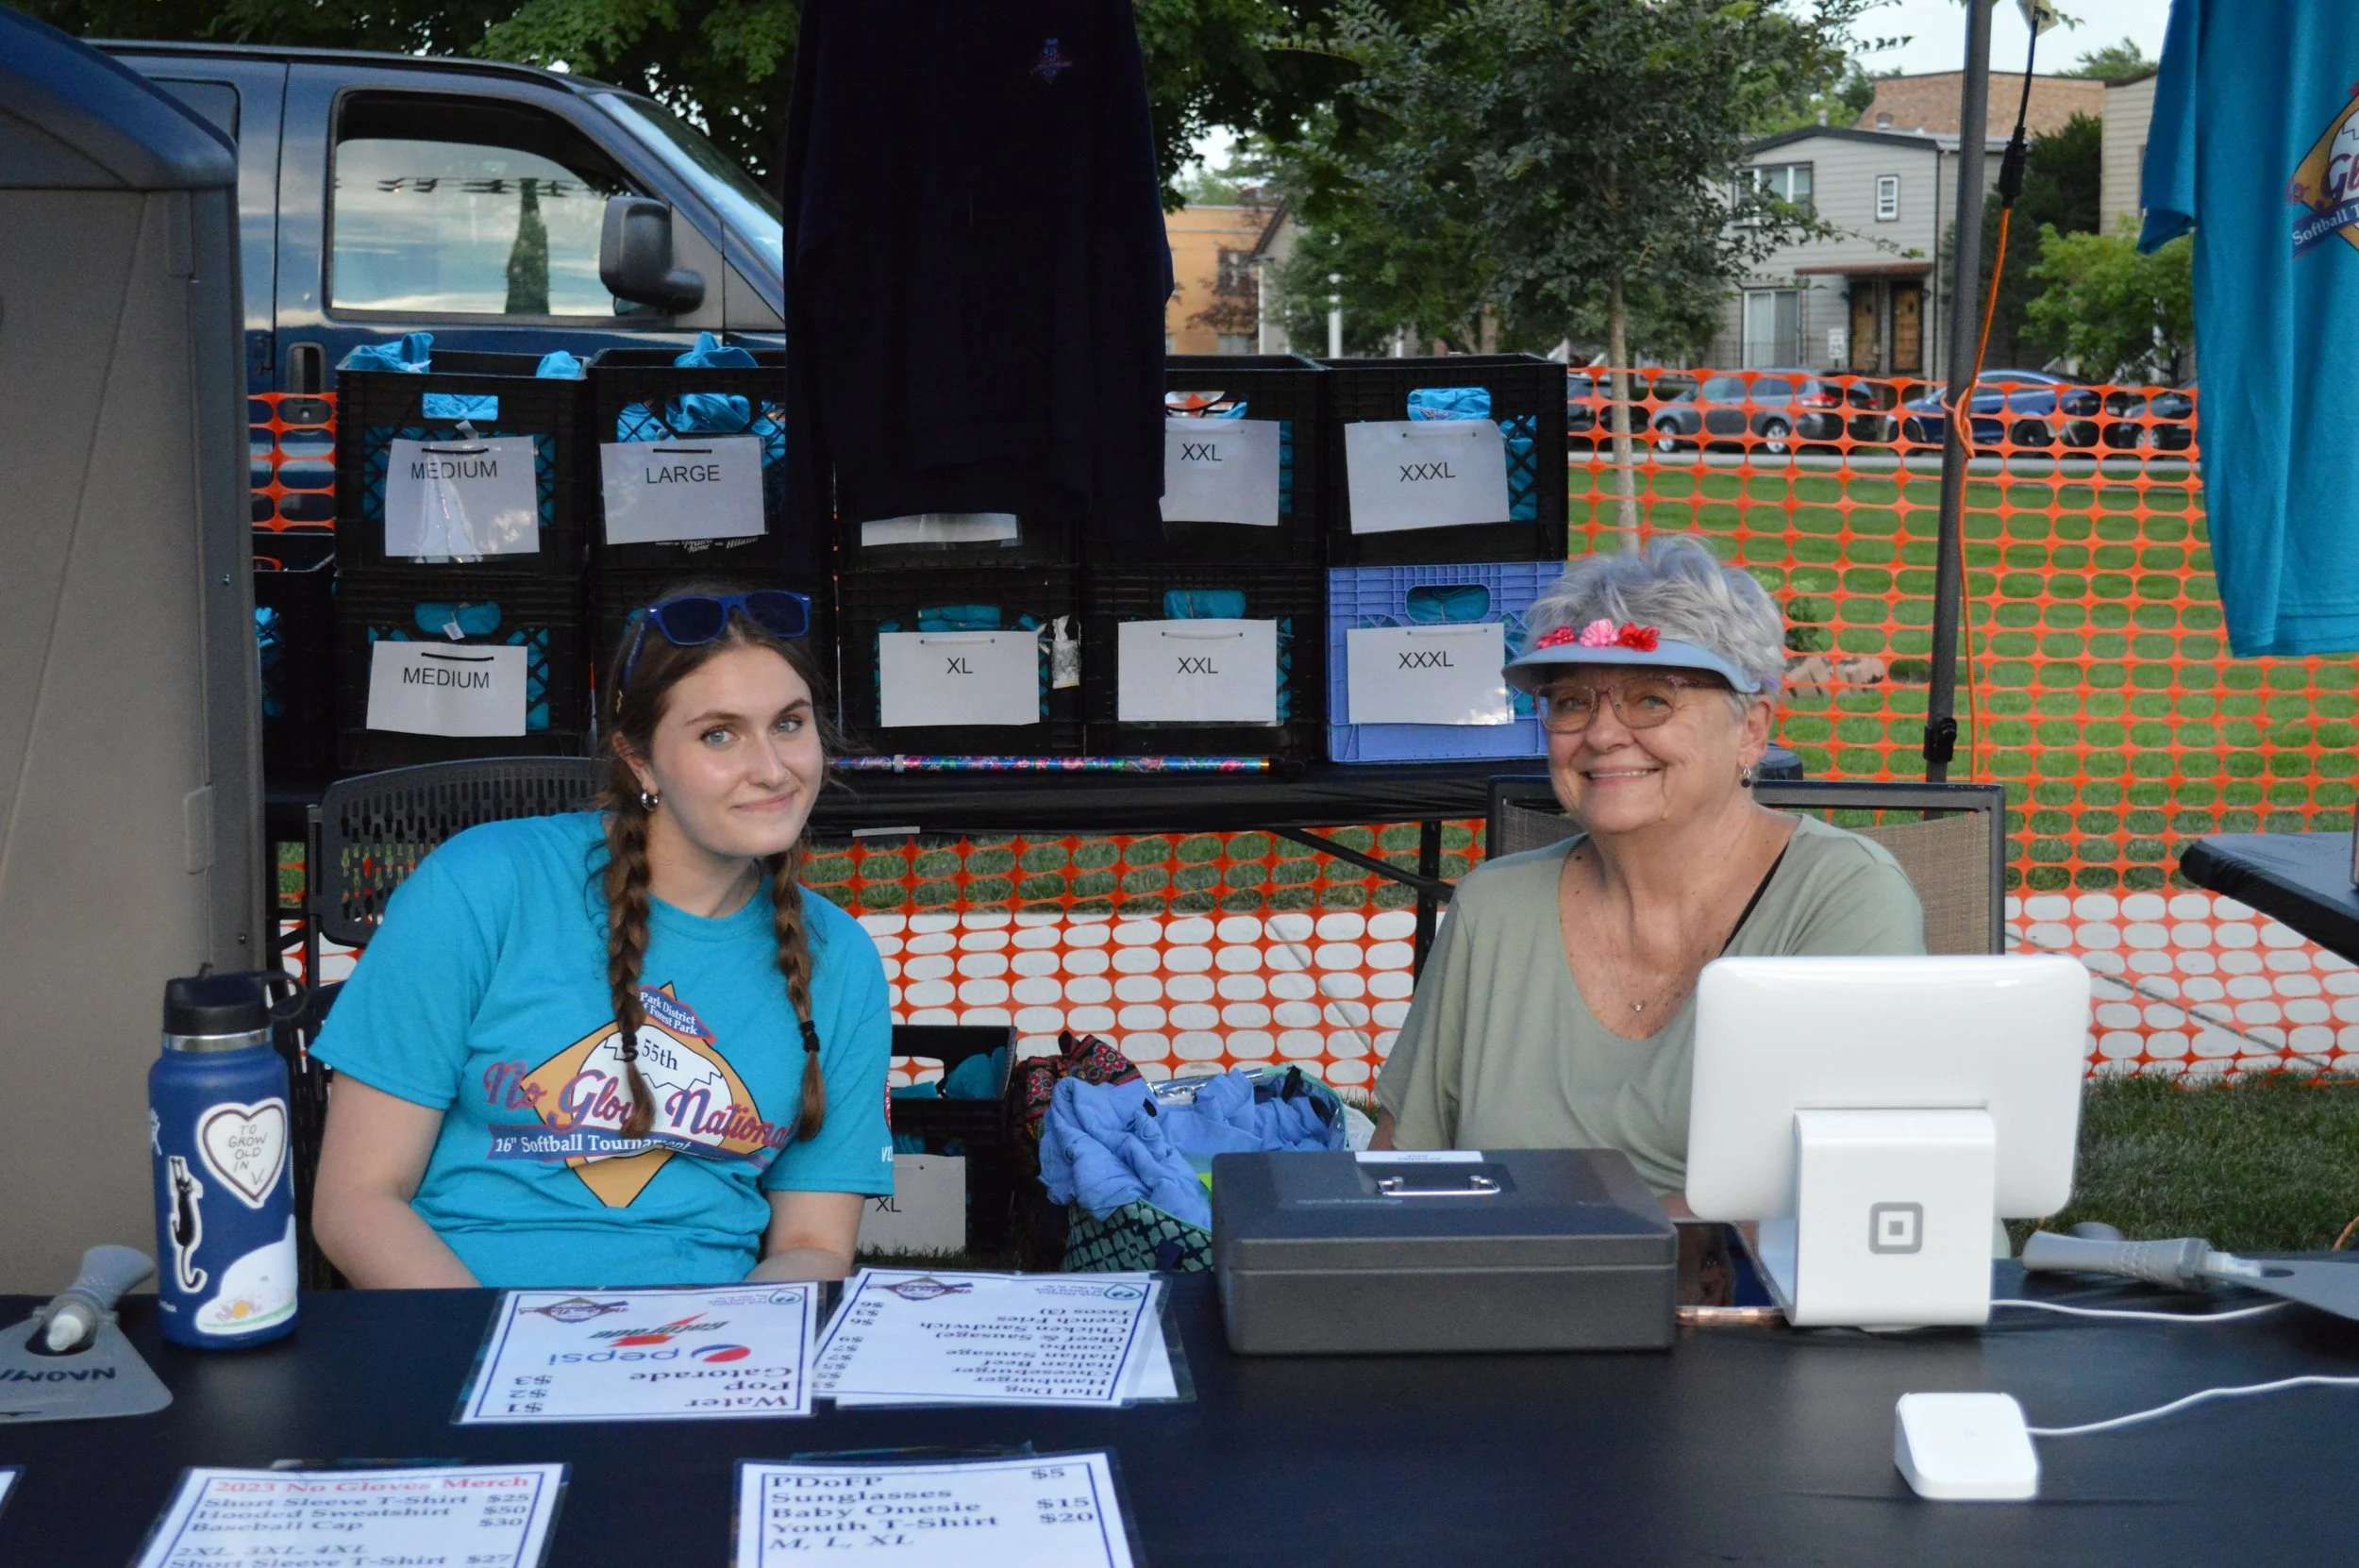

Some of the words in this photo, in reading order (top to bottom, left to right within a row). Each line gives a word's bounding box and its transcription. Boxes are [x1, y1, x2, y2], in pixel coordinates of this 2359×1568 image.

[2292, 208, 2350, 245] Softball
[1181, 443, 1223, 461] XXL
[410, 459, 498, 480] MEDIUM
[645, 464, 721, 484] LARGE
[1399, 461, 1456, 482] XXXL
[946, 657, 974, 675] XL
[1177, 657, 1219, 675] XXL
[1398, 650, 1455, 669] XXXL
[403, 666, 490, 689] MEDIUM
[640, 992, 661, 1009] Park
[662, 1001, 696, 1025] District
[650, 1004, 673, 1026] Forest
[674, 1020, 698, 1035] Park
[642, 1038, 678, 1071] 55th
[483, 1060, 547, 1111] No
[240, 1124, 258, 1136] TO
[228, 1132, 268, 1148] GROW
[495, 1136, 518, 1153] 16"
[521, 1133, 584, 1153] Softball
[234, 1146, 262, 1160] OLD
[233, 1160, 250, 1172] IN
[876, 1196, 902, 1212] XL
[920, 1322, 1028, 1332] Sandwich
[996, 1315, 1048, 1324] Fries
[935, 1331, 1032, 1341] Sausage)
[1035, 1326, 1127, 1334] Chicken
[548, 1347, 680, 1366] pepsi
[945, 1348, 1037, 1359] Sausage
[0, 1367, 116, 1382] NAOMI
[629, 1366, 793, 1382] Gatorade
[953, 1367, 1113, 1376] Cheeseburger
[514, 1374, 553, 1386] $3
[722, 1380, 792, 1391] Pop
[973, 1376, 1107, 1385] Hamburger
[508, 1388, 548, 1398] $2
[1004, 1384, 1053, 1394] Dog
[1062, 1388, 1103, 1396] Hot
[507, 1401, 544, 1413] $1
[684, 1395, 790, 1408] Water
[213, 1480, 276, 1492] 2023
[285, 1482, 326, 1493] No
[334, 1480, 431, 1493] Gloves
[443, 1476, 529, 1489] Merch
[772, 1476, 883, 1488] PDoFP
[1031, 1468, 1065, 1479] $5
[204, 1497, 276, 1507] Short
[284, 1497, 368, 1507] Sleeve
[376, 1494, 470, 1505] T-Shirt
[487, 1493, 529, 1504] $25
[771, 1490, 952, 1504] Sunglasses
[198, 1510, 303, 1520] Hooded
[310, 1508, 451, 1518] Sweatshirt
[483, 1505, 527, 1516] $50
[772, 1506, 853, 1520] Baby
[864, 1501, 982, 1515] Onesie
[1036, 1496, 1090, 1510] $15
[192, 1520, 304, 1532] Baseball
[310, 1520, 365, 1533] Cap
[771, 1520, 868, 1534] Youth
[878, 1515, 998, 1530] T-Shirt
[1039, 1511, 1094, 1524] $20
[768, 1538, 811, 1551] M,
[826, 1535, 853, 1548] L,
[866, 1532, 914, 1545] XL
[170, 1558, 243, 1568] Short
[251, 1556, 341, 1568] Sleeve
[350, 1554, 446, 1566] T-Shirt
